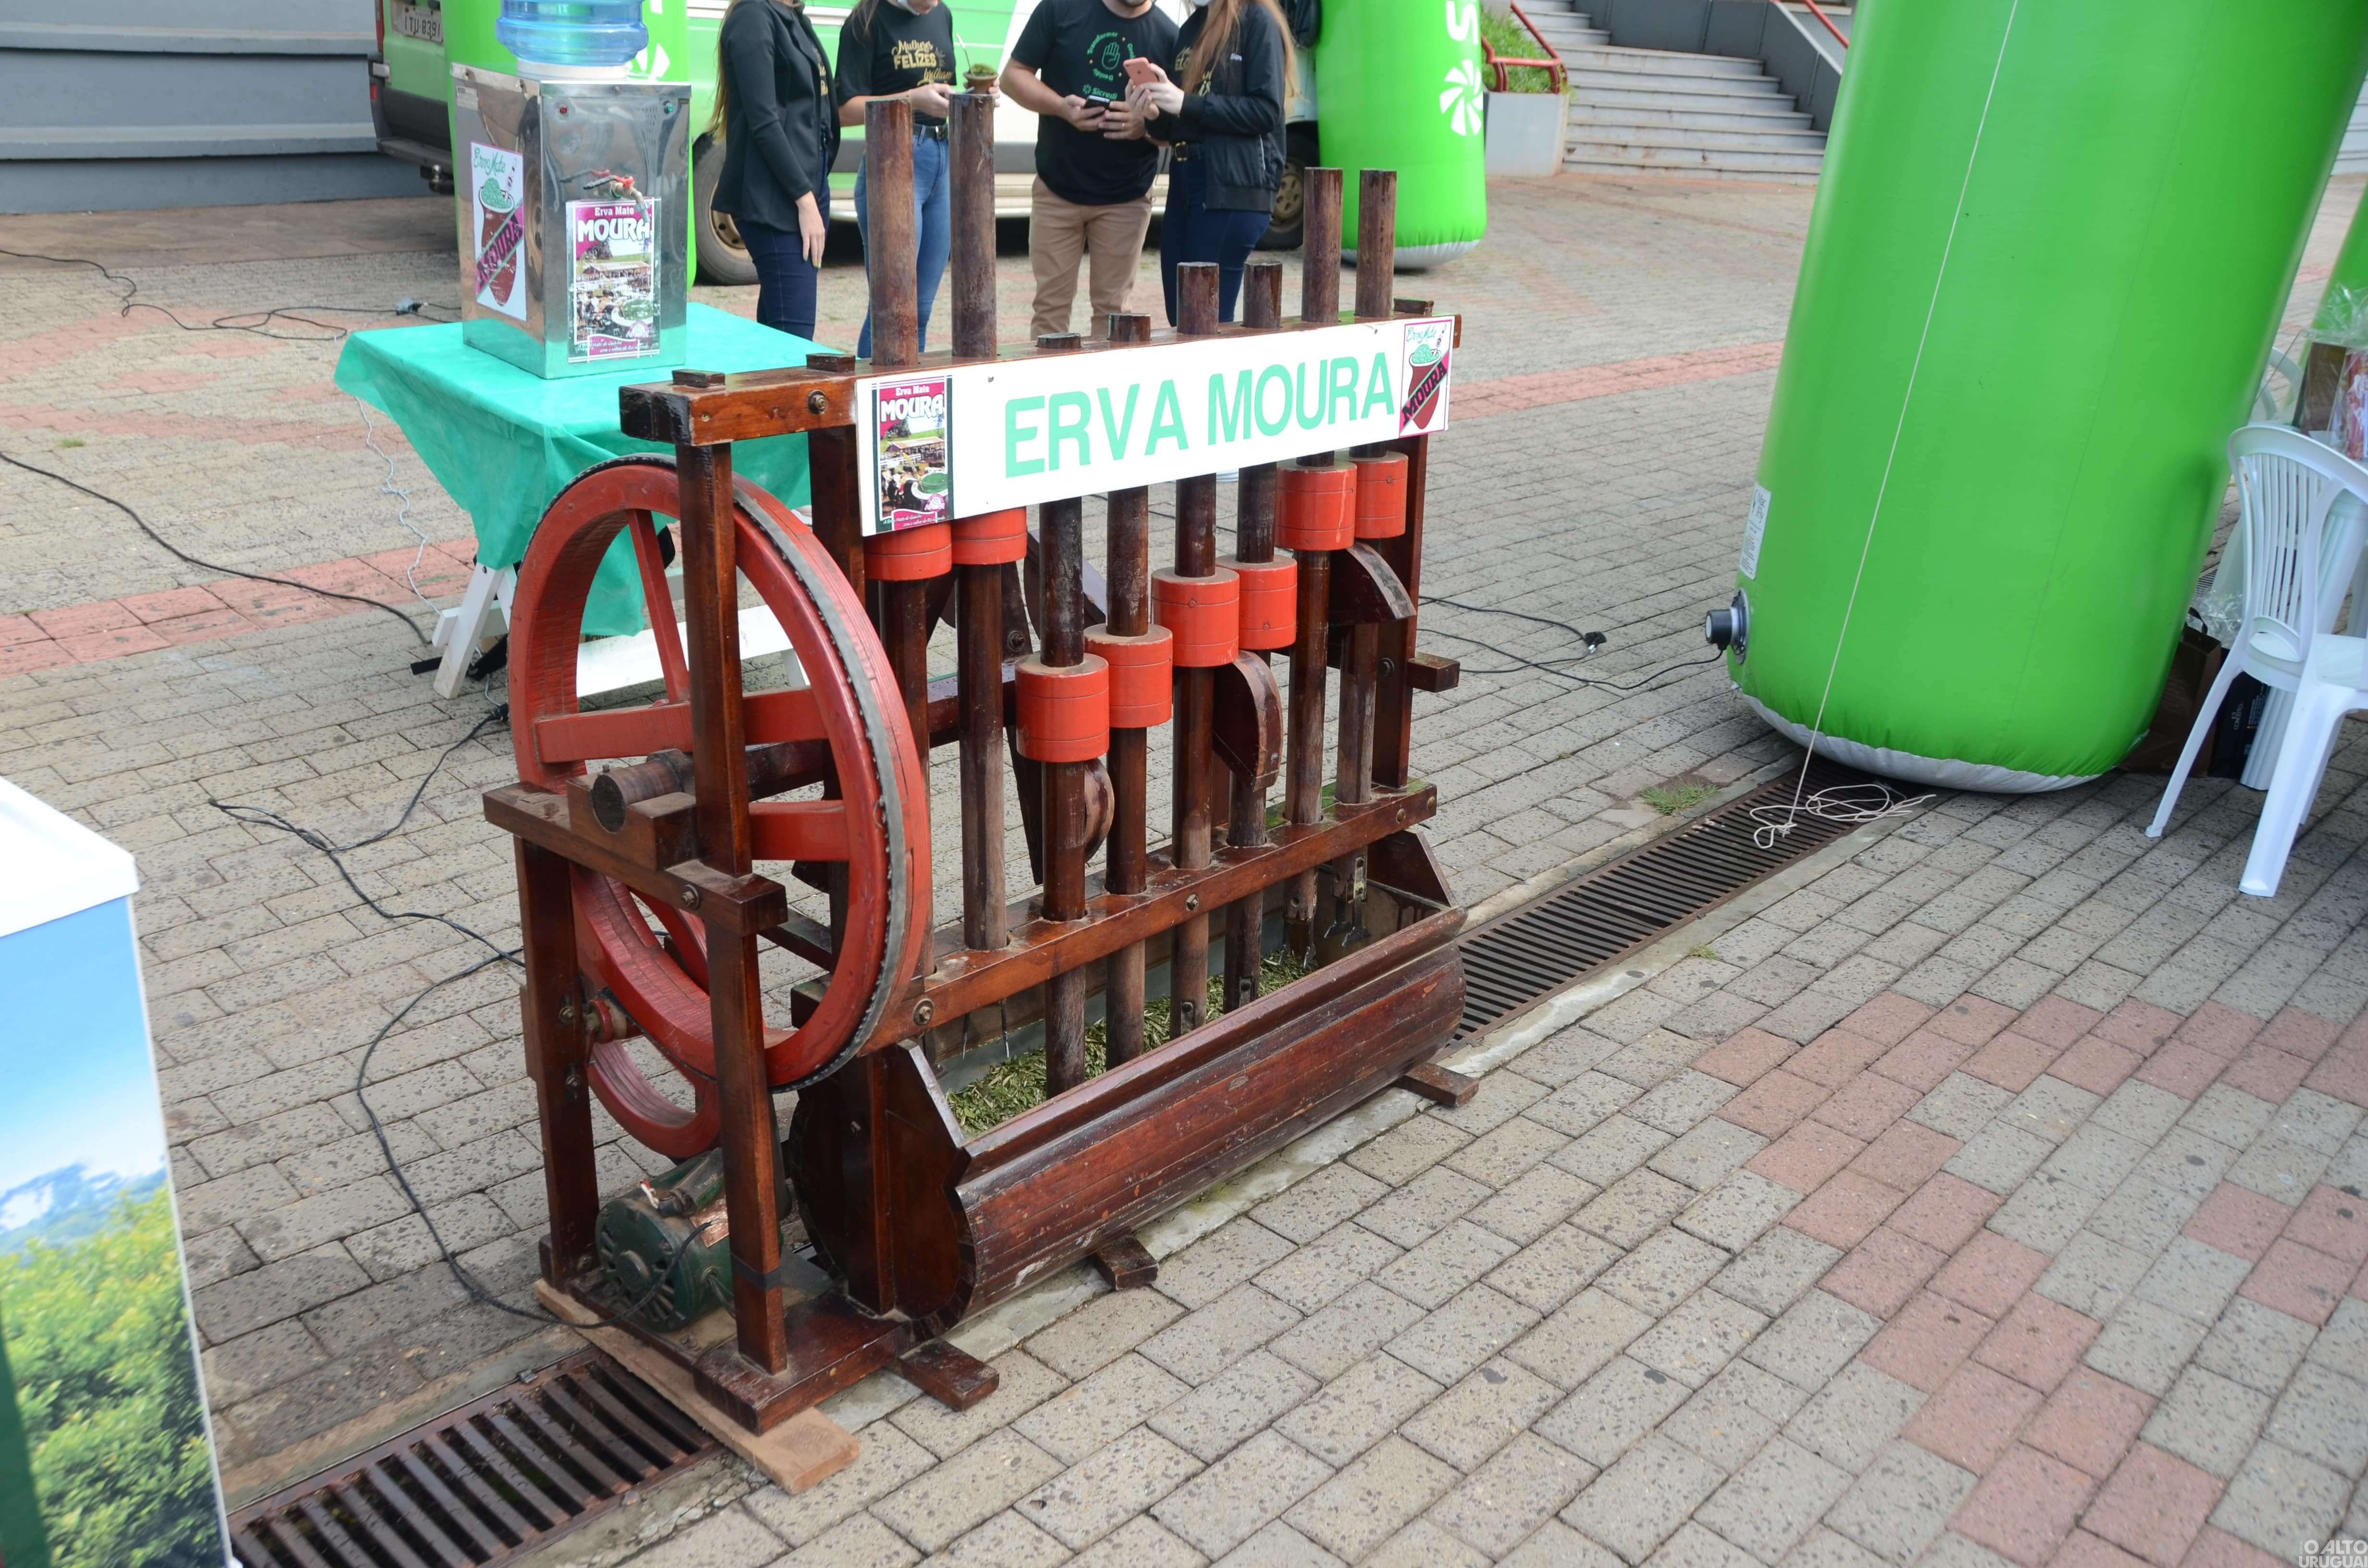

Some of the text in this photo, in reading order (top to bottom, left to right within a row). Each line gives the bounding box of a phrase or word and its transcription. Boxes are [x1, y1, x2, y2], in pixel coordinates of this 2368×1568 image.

[894, 50, 937, 70] FELIZES
[1092, 87, 1118, 100] Sicredi
[595, 206, 634, 216] Erva Mate
[577, 217, 650, 243] MOURA
[895, 385, 930, 396] Erva Mate
[1402, 361, 1447, 427] MOURA
[880, 393, 943, 422] MOURA
[1005, 352, 1395, 478] ERVA MOURA
